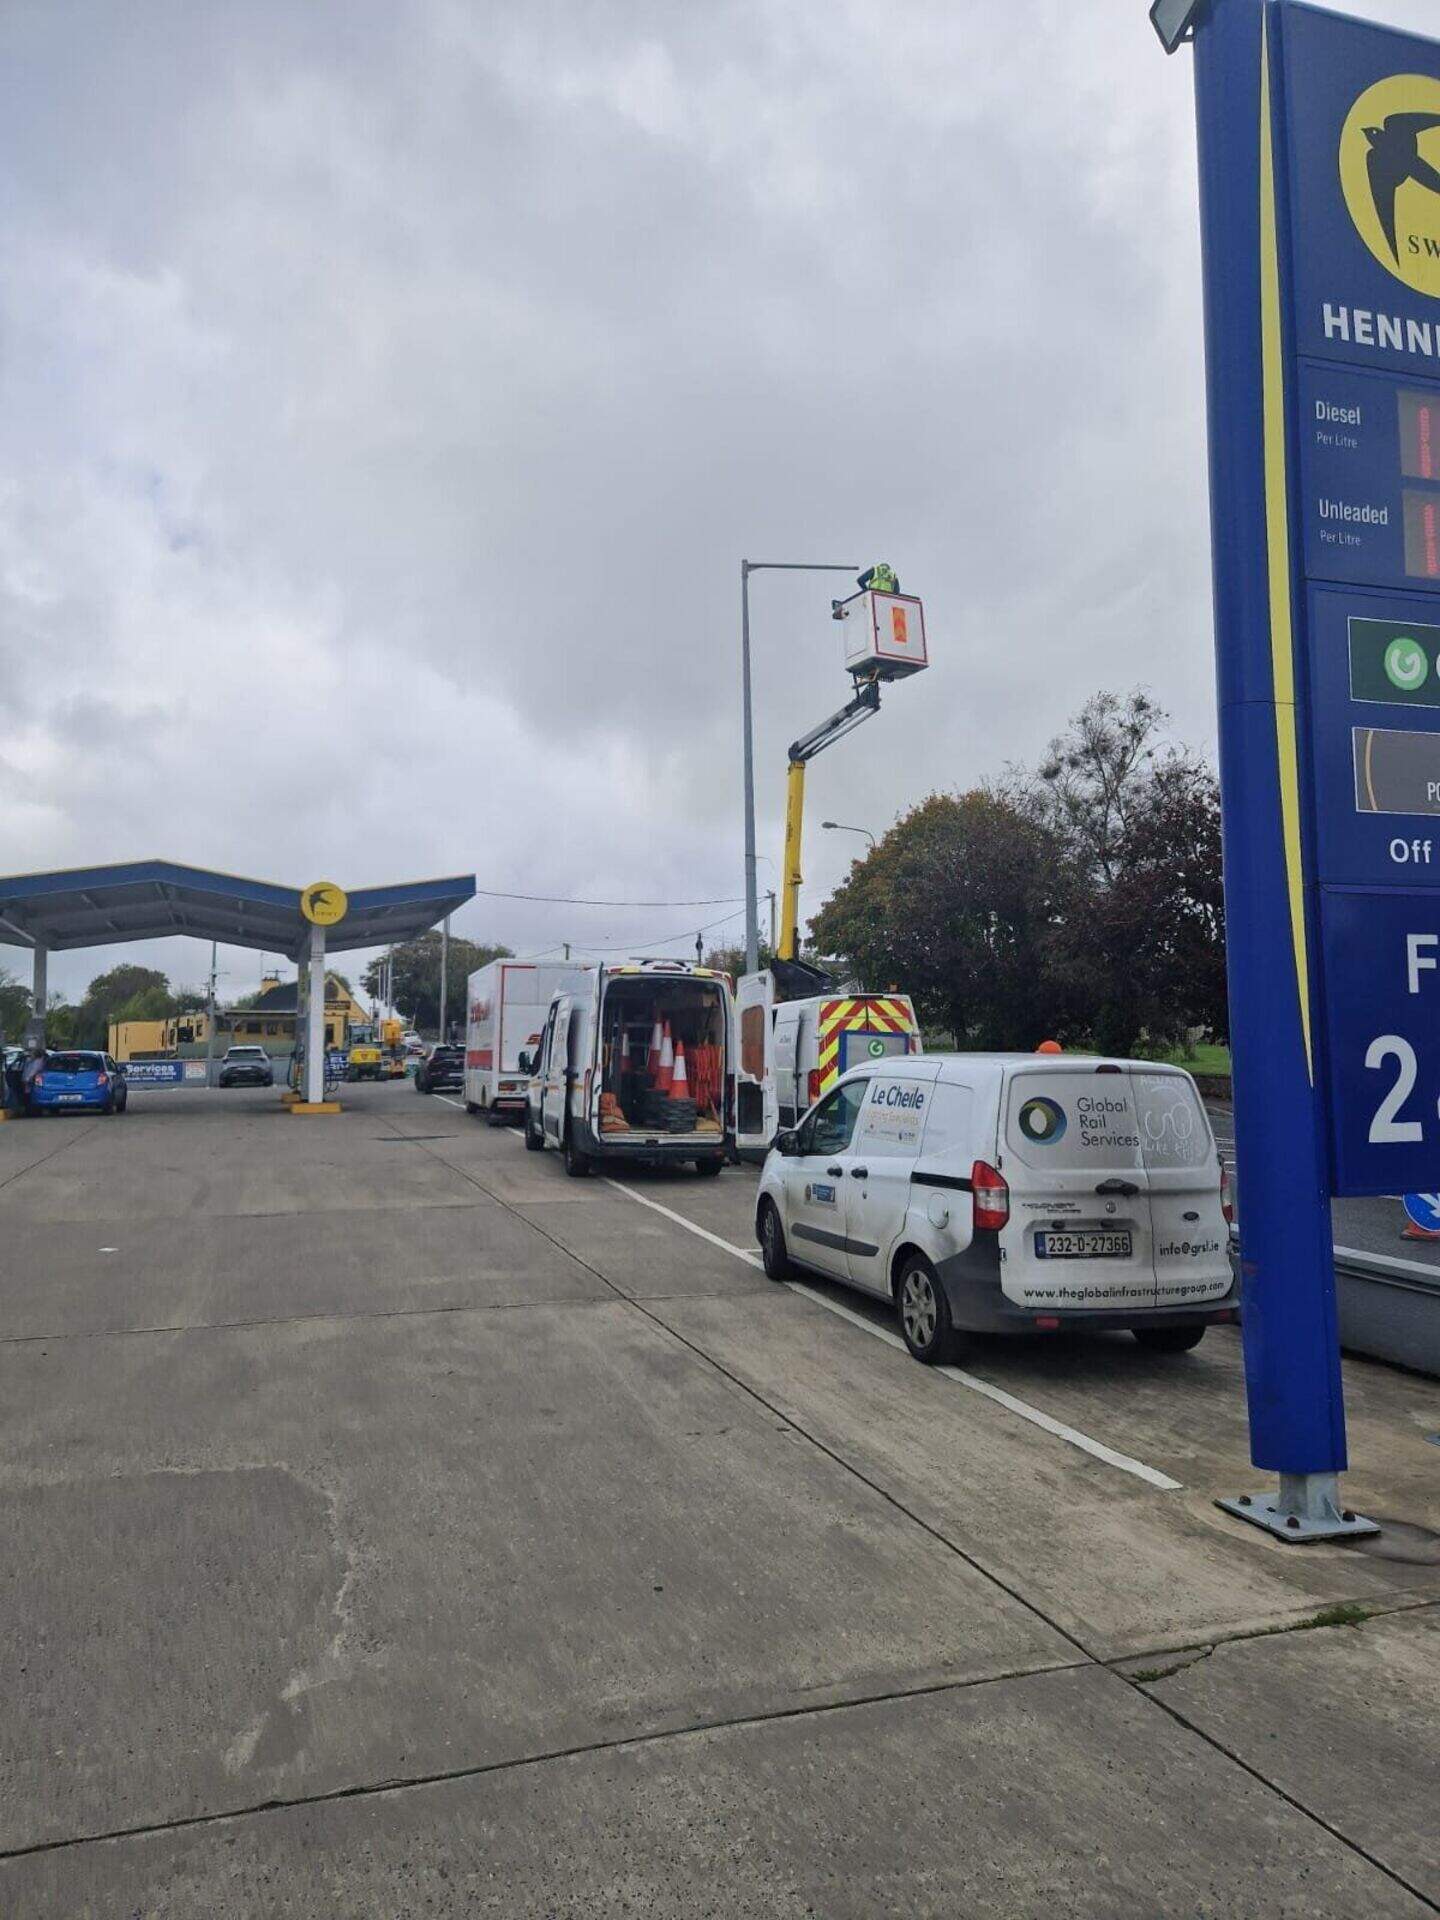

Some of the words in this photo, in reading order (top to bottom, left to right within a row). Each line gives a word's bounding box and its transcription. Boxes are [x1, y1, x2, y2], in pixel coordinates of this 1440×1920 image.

[1323, 303, 1440, 357] HENN
[1315, 400, 1361, 425] Diesel
[1316, 431, 1332, 445] Per
[1335, 434, 1358, 448] Litre
[1319, 499, 1388, 525] Unleaded
[1320, 529, 1336, 543] Per
[1338, 531, 1361, 546] Litre
[1389, 838, 1432, 864] Off
[126, 1063, 175, 1073] Services
[871, 1085, 885, 1104] Le
[1365, 1035, 1440, 1143] 2
[1077, 1097, 1128, 1113] Global
[1079, 1115, 1106, 1130] Rail
[1081, 1131, 1140, 1147] Services
[1048, 1236, 1129, 1253] 232-D-27366
[1024, 1281, 1225, 1301] www.theglobalinfrastructuregroup.com
